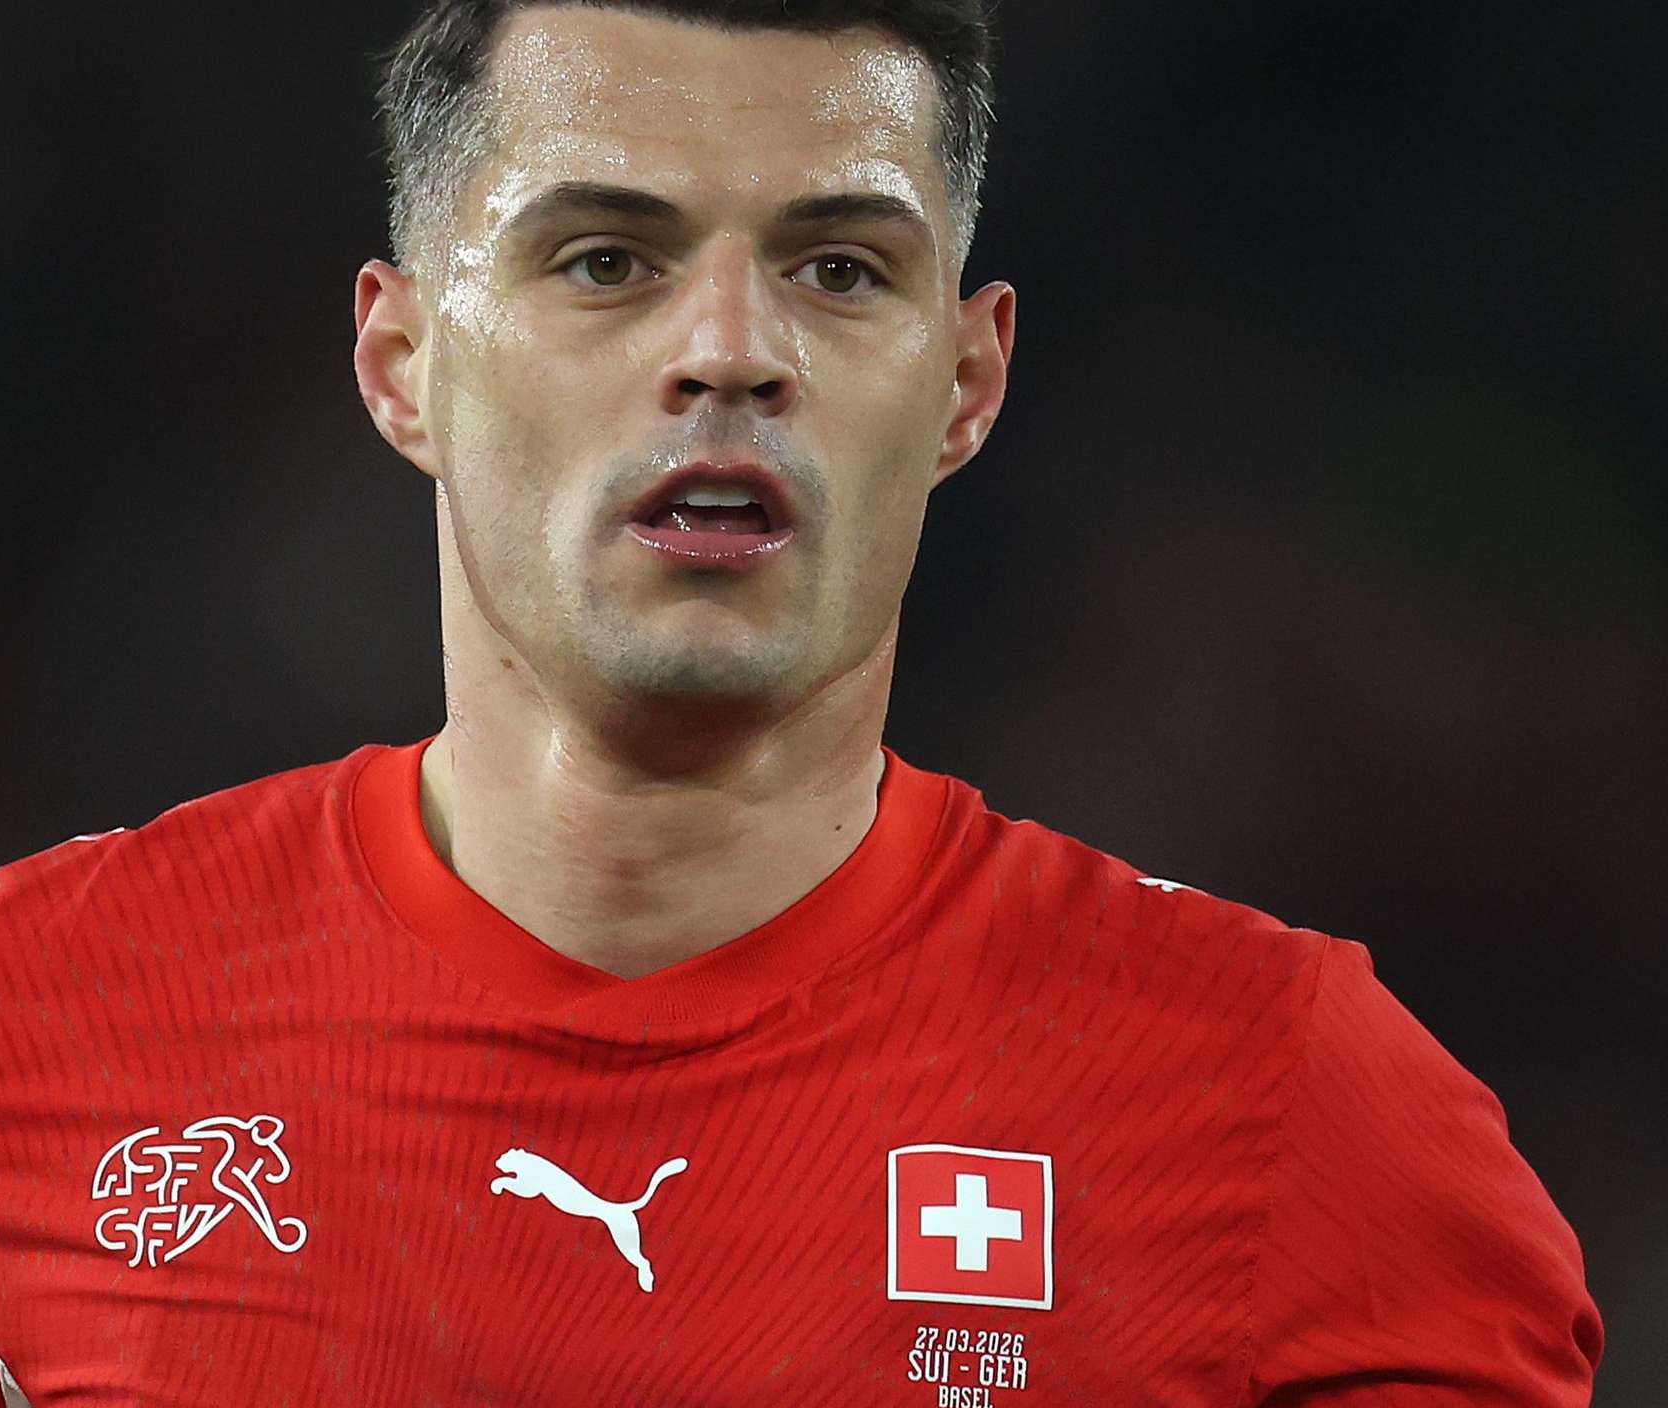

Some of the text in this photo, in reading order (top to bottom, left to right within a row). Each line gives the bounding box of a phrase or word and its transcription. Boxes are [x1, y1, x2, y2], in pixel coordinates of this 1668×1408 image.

[914, 1326, 1025, 1356] 27.03.2026
[907, 1349, 950, 1383] SUI
[979, 1355, 1028, 1390] GER
